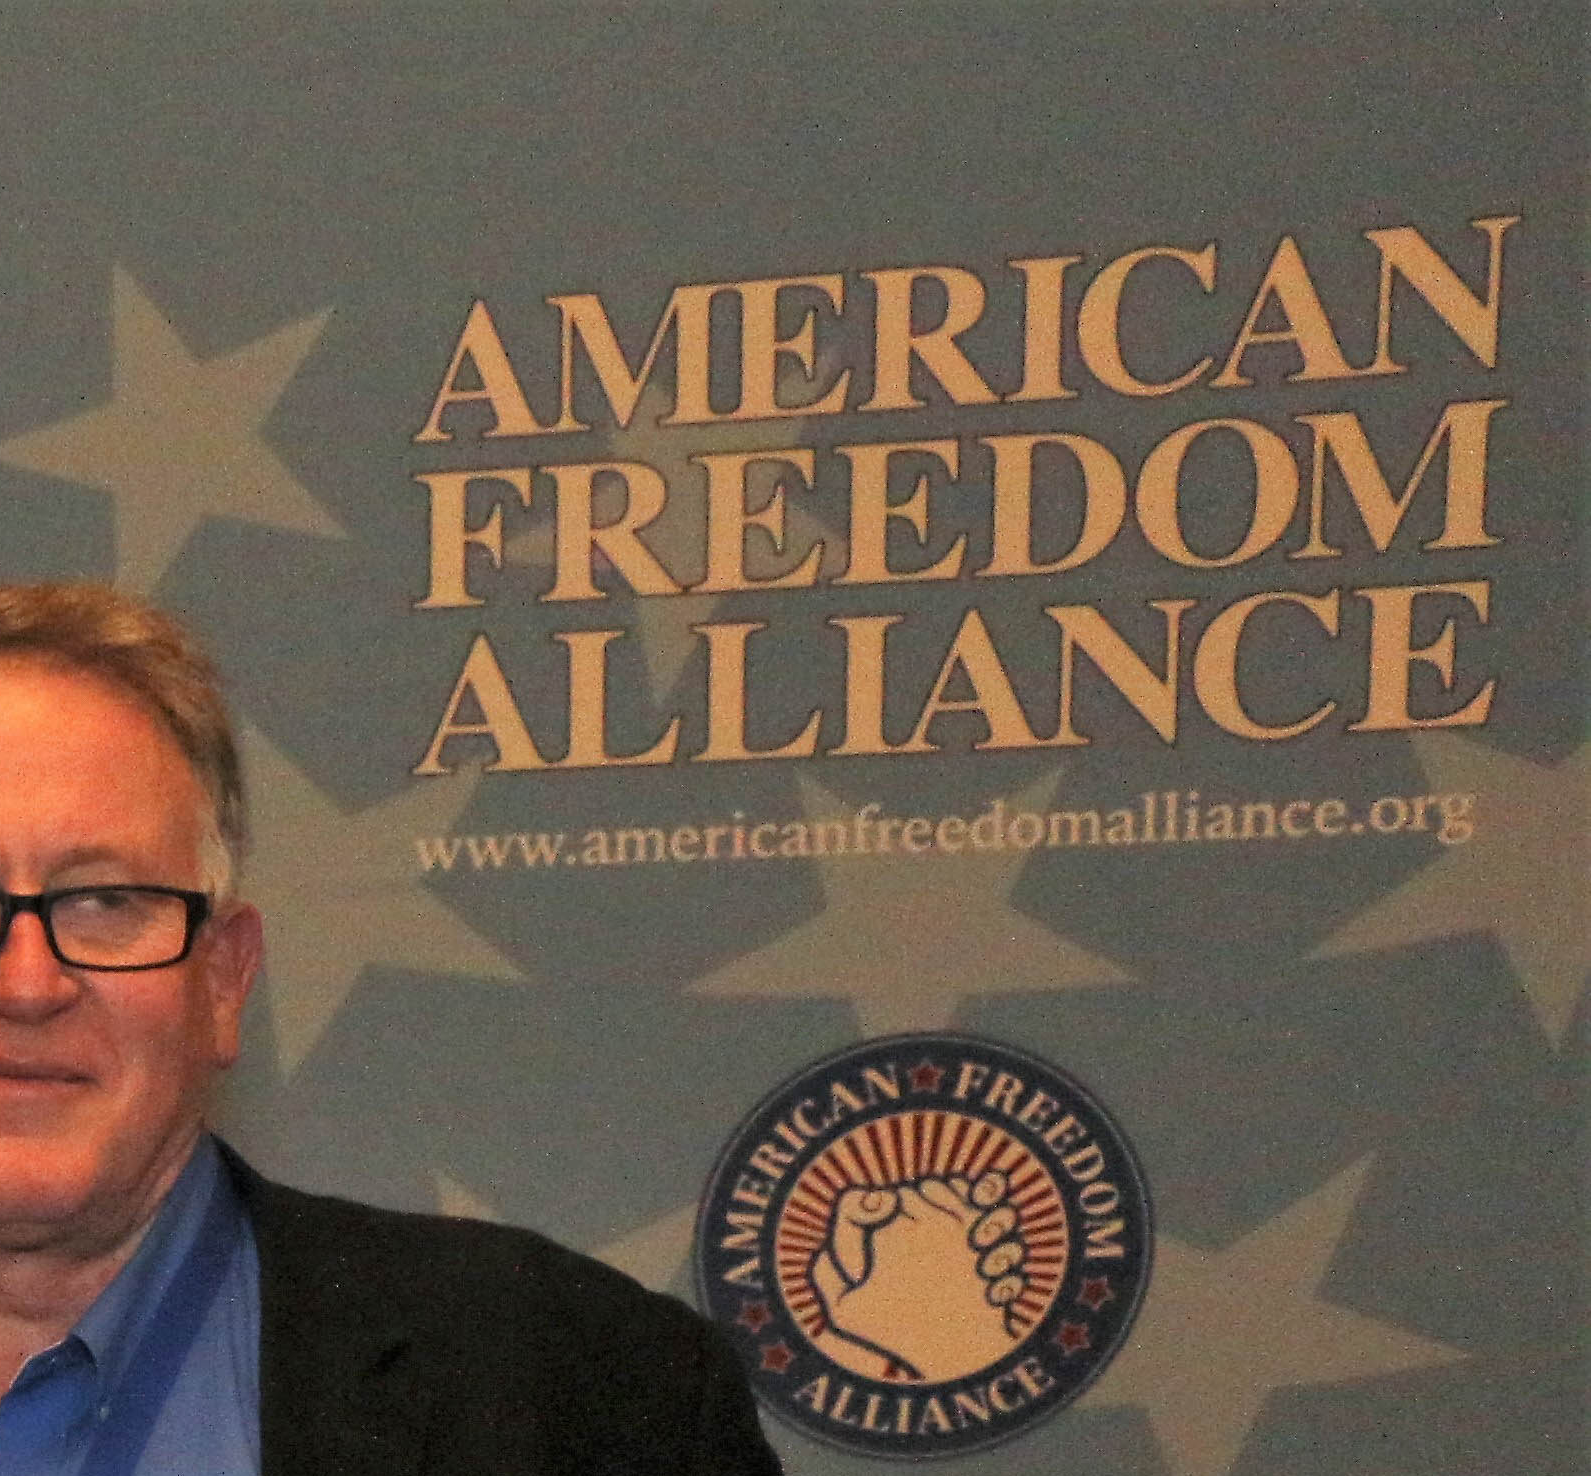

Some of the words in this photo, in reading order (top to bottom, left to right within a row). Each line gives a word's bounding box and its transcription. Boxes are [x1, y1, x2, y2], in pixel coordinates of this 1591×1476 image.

[413, 216, 1522, 442] AMERICAN
[414, 400, 1509, 609] FREEDOM
[413, 581, 1498, 776] ALLIANCE
[417, 789, 1476, 874] www.americanfreedomalliance.org
[722, 1063, 902, 1289] AMERICAN
[954, 1061, 1125, 1259] FREEDOM
[794, 1357, 1057, 1435] ALLIANCE
